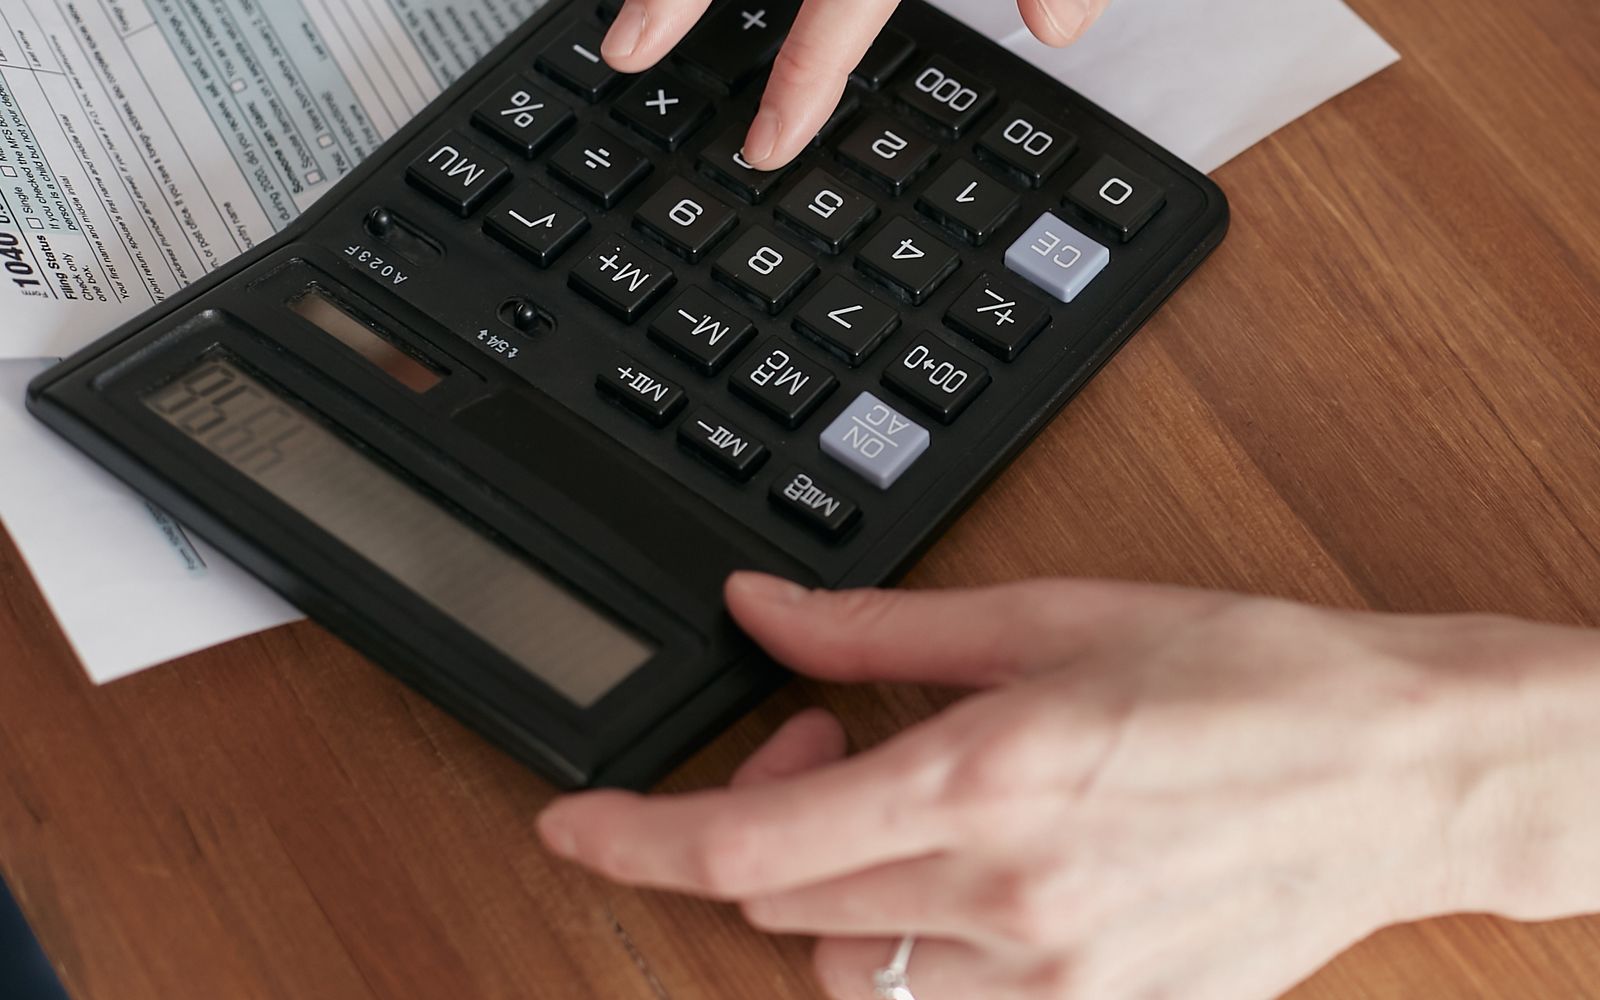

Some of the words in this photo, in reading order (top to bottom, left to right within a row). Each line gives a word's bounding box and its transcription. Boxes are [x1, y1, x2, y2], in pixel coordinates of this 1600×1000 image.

[915, 68, 978, 112] 000
[8, 109, 25, 127] your
[2, 129, 19, 148] MFS
[17, 129, 30, 142] not
[236, 130, 253, 150] you
[264, 129, 278, 148] can
[872, 130, 908, 159] 2
[1003, 118, 1053, 156] 00
[16, 151, 27, 165] the
[26, 145, 39, 159] but
[244, 148, 259, 167] did
[33, 160, 50, 181] child
[84, 160, 98, 174] and
[158, 163, 172, 184] have
[274, 148, 304, 194] Someone
[428, 146, 484, 186] MU
[20, 166, 47, 203] checked
[59, 175, 76, 195] initial
[95, 176, 110, 197] name
[168, 182, 183, 199] you
[956, 181, 978, 202] 1
[1098, 178, 1133, 205] 0
[15, 186, 34, 212] Single
[73, 197, 90, 222] middle
[106, 199, 118, 212] first
[268, 191, 291, 221] during
[808, 189, 844, 219] 5
[42, 205, 59, 221] you
[55, 201, 78, 230] person
[223, 200, 240, 224] name
[668, 199, 704, 226] 9
[85, 224, 99, 239] and
[192, 229, 210, 248] post
[0, 232, 40, 288] 1040
[36, 235, 60, 268] Status
[96, 240, 111, 263] name
[204, 248, 213, 258] or
[892, 238, 925, 260] 4
[1030, 230, 1082, 268] CE
[62, 252, 77, 271] only
[106, 264, 119, 279] first
[166, 248, 187, 278] address
[748, 246, 784, 275] 8
[599, 254, 649, 292] M+
[55, 272, 78, 299] Filing
[72, 273, 94, 300] Check
[93, 285, 107, 301] one
[115, 281, 130, 299] Your
[148, 277, 164, 294] joint
[828, 305, 863, 328] 7
[865, 404, 910, 435] AC
[842, 426, 885, 458] ON
